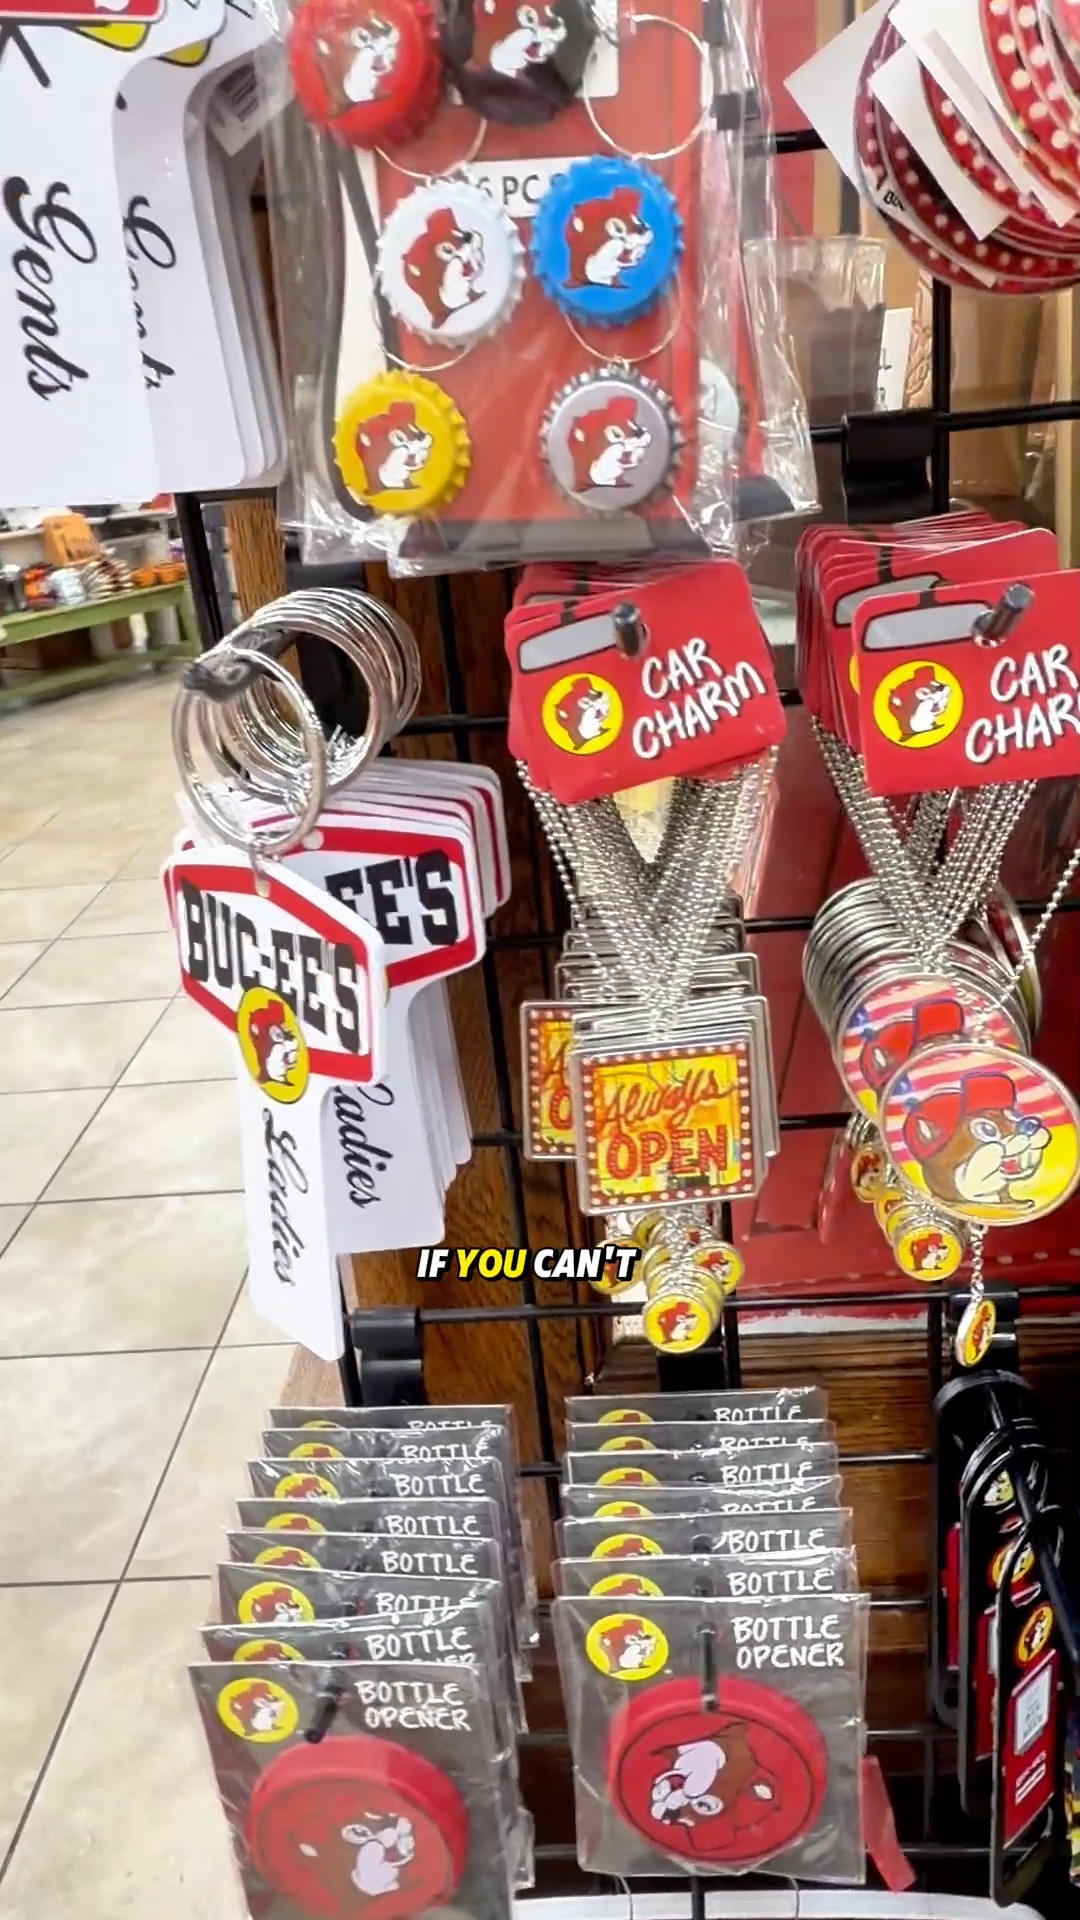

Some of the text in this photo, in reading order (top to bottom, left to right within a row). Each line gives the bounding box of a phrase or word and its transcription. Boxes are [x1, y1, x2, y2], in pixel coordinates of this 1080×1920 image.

[3, 176, 98, 400] Gents
[641, 637, 723, 700] CAR
[989, 643, 1079, 702] CAR
[632, 661, 767, 760] CHARM
[968, 692, 1080, 764] CHAR
[180, 876, 361, 1056] BUC-EE'S
[597, 1067, 738, 1138] Always
[605, 1123, 727, 1180] OPEN
[262, 1107, 310, 1287] Ladies
[389, 1473, 486, 1496] BOTTLE
[384, 1515, 481, 1536] BOTTLE
[728, 1528, 826, 1553] BOTTLE
[381, 1551, 479, 1575] BOTTLE
[726, 1567, 835, 1596] BOTTLE
[364, 1626, 472, 1661] BOTTLE
[731, 1614, 841, 1644] BOTTLE
[736, 1642, 844, 1670] OPENER
[354, 1680, 464, 1704] BOTTLE
[365, 1706, 472, 1732] OPENER
